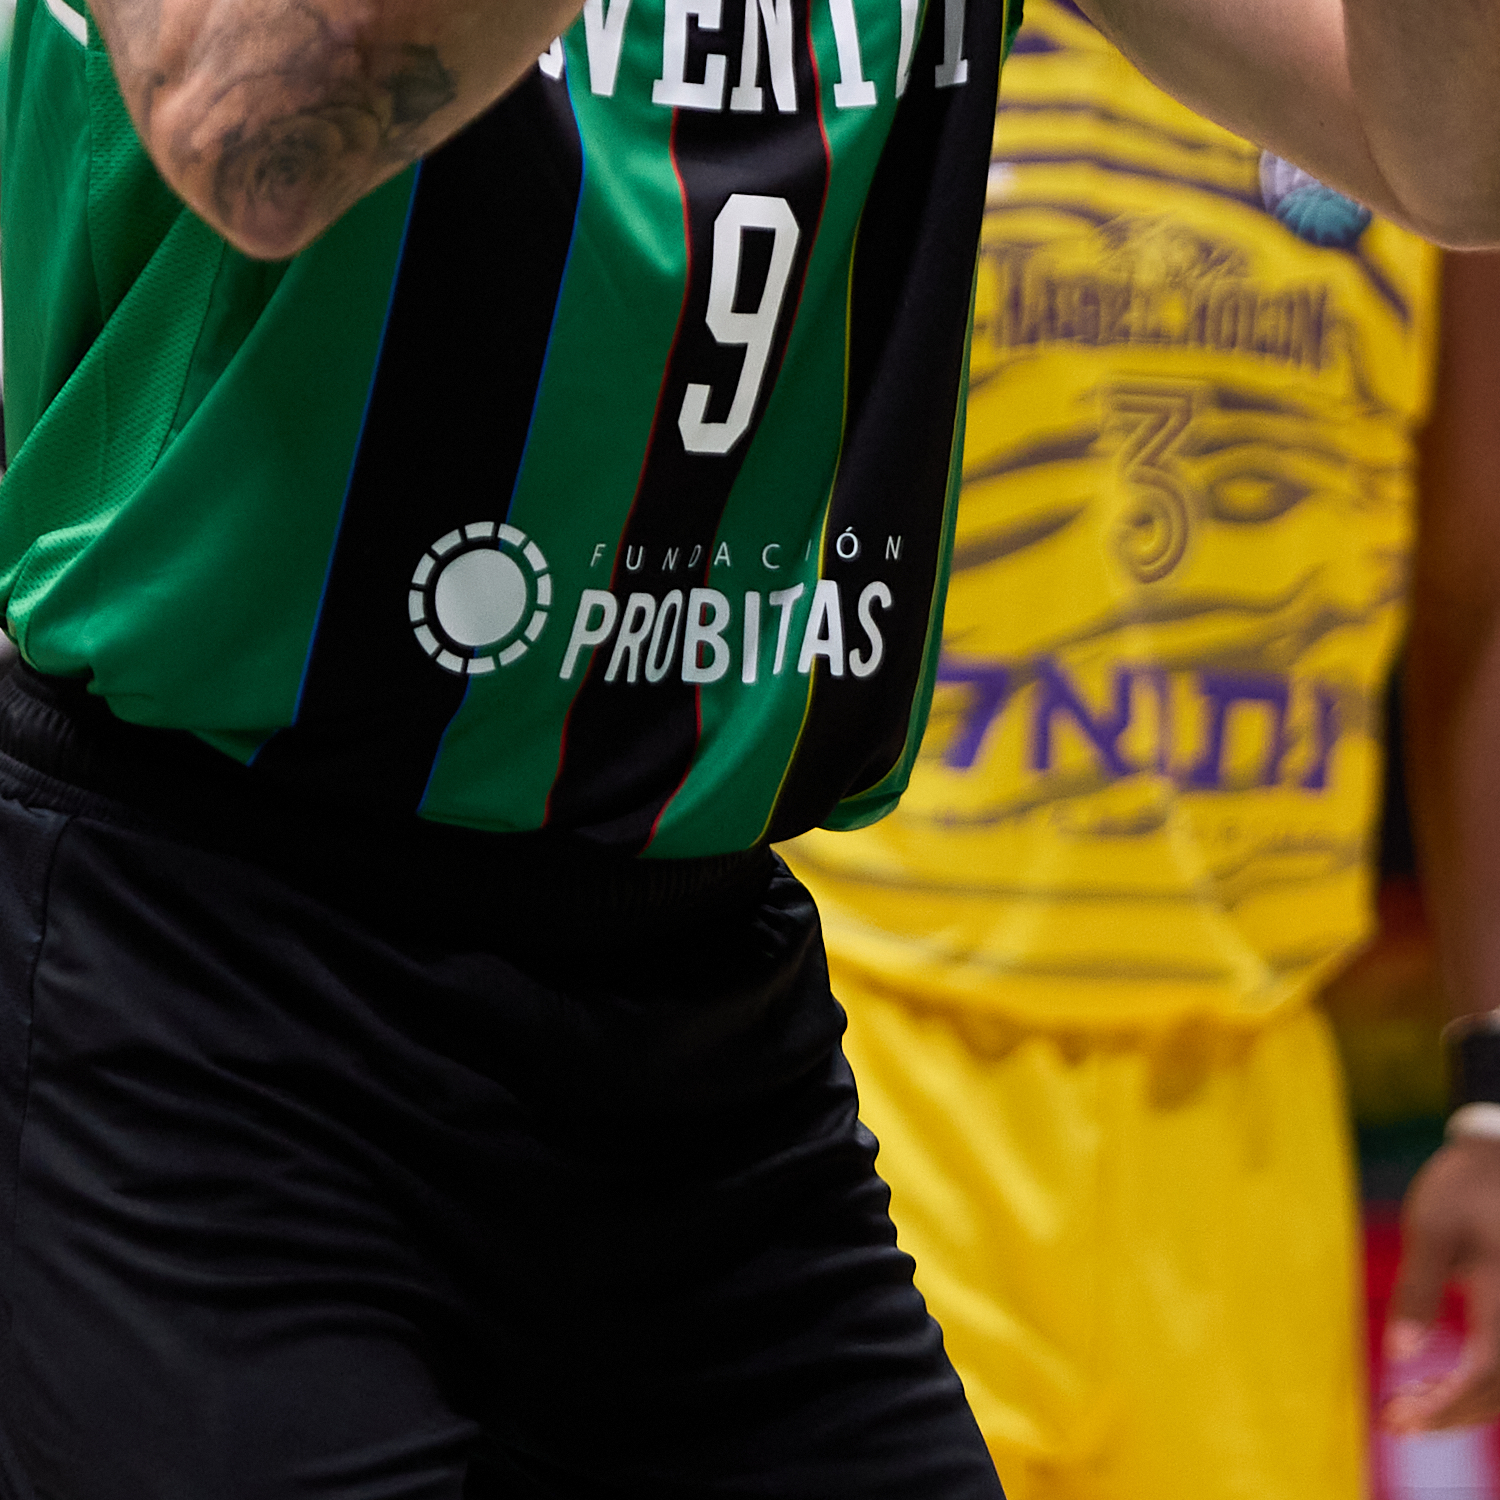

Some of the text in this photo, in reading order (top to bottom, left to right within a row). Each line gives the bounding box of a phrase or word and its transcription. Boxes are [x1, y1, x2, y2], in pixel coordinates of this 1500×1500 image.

[677, 193, 800, 454] 9
[590, 526, 902, 572] FUNDACIÓN
[1104, 374, 1196, 585] 3
[558, 579, 893, 684] PROBITAS
